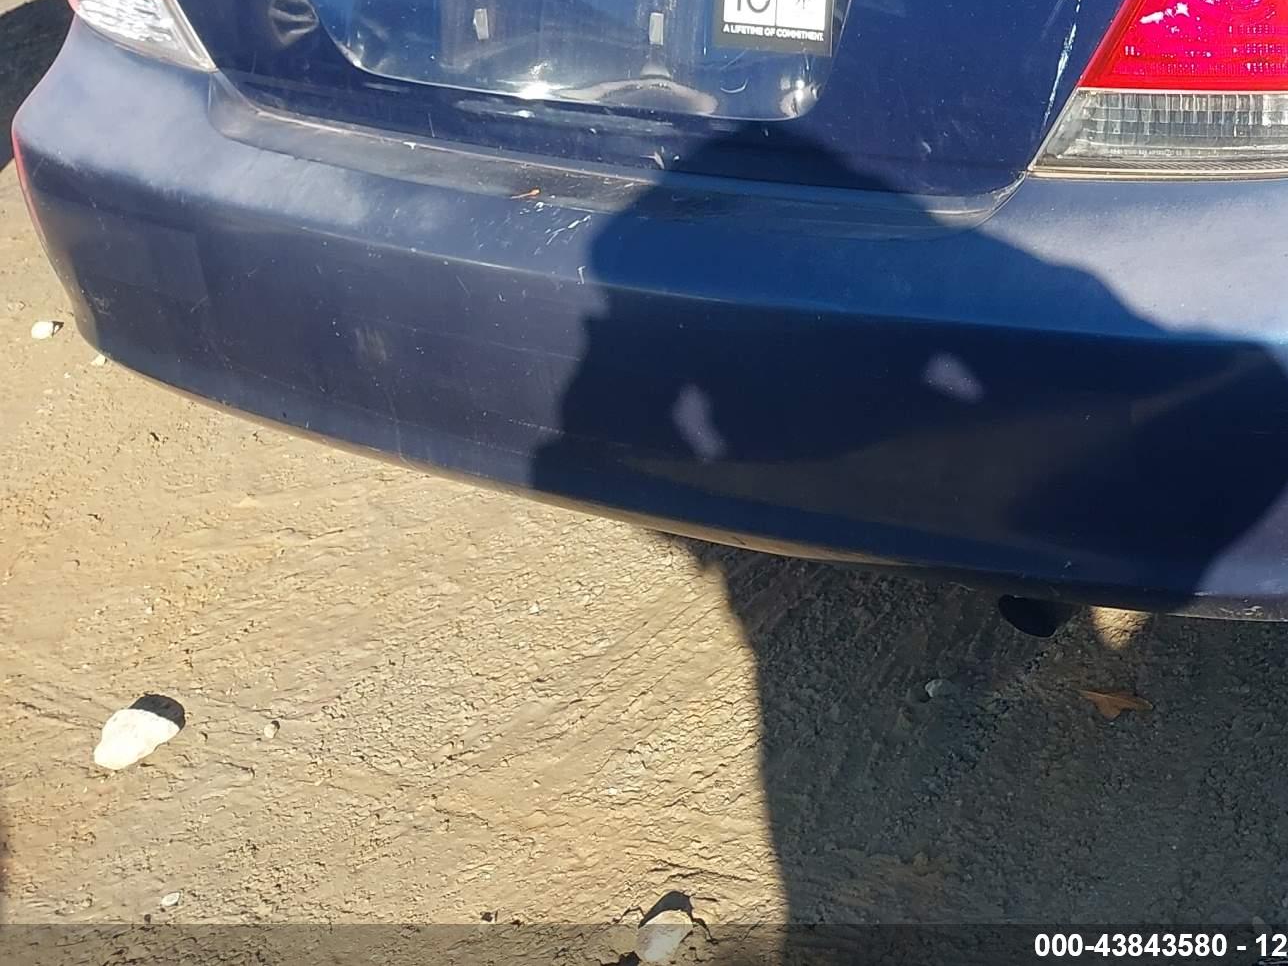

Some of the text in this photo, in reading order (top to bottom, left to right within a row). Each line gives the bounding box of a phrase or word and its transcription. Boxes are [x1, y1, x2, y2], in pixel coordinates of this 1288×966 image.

[723, 24, 730, 32] A
[731, 25, 764, 36] LIFETIME
[764, 28, 776, 37] OF
